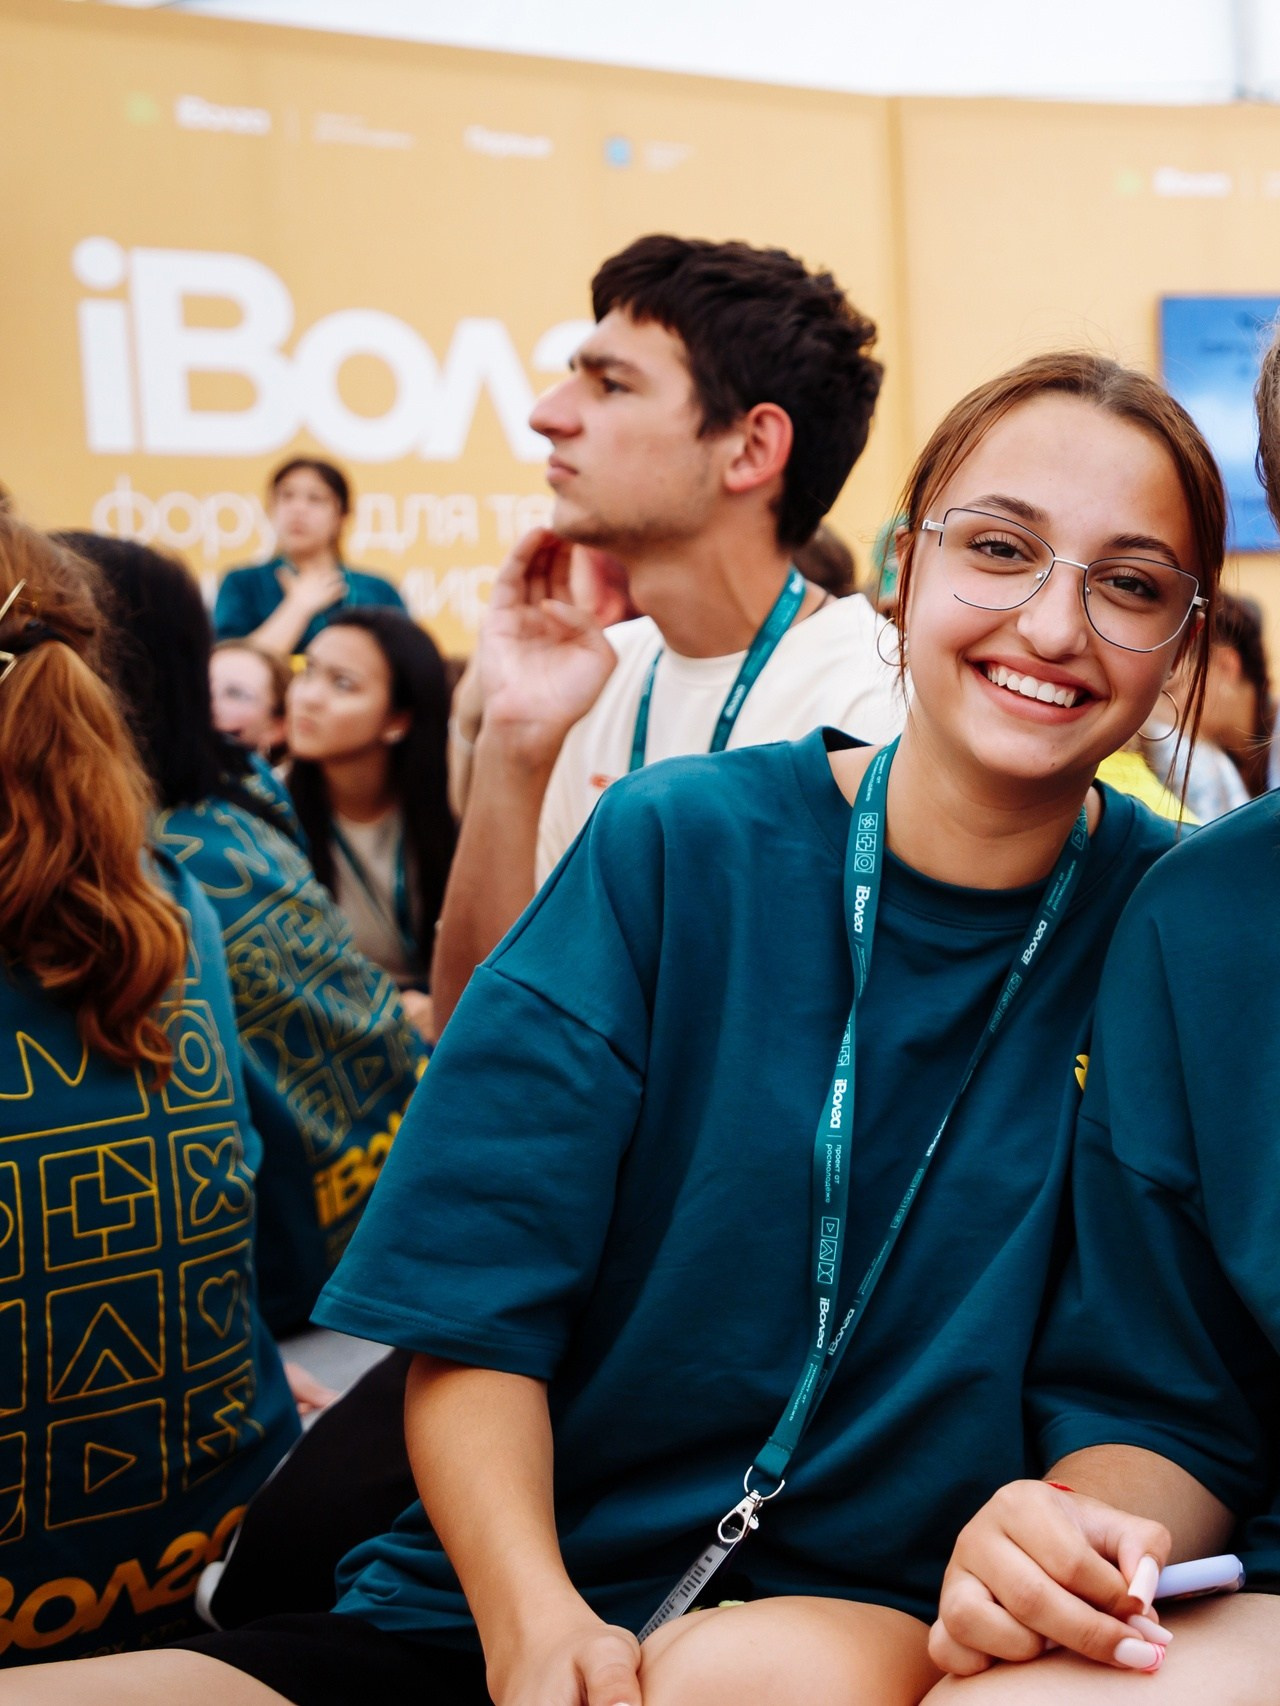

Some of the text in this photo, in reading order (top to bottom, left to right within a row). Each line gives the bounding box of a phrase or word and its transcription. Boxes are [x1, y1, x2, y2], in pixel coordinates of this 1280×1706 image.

[72, 236, 602, 464] iВол
[854, 885, 871, 934] iВолга
[1020, 919, 1048, 966] iВолга
[828, 1078, 848, 1129] iВолга
[816, 1297, 831, 1350] iВолга
